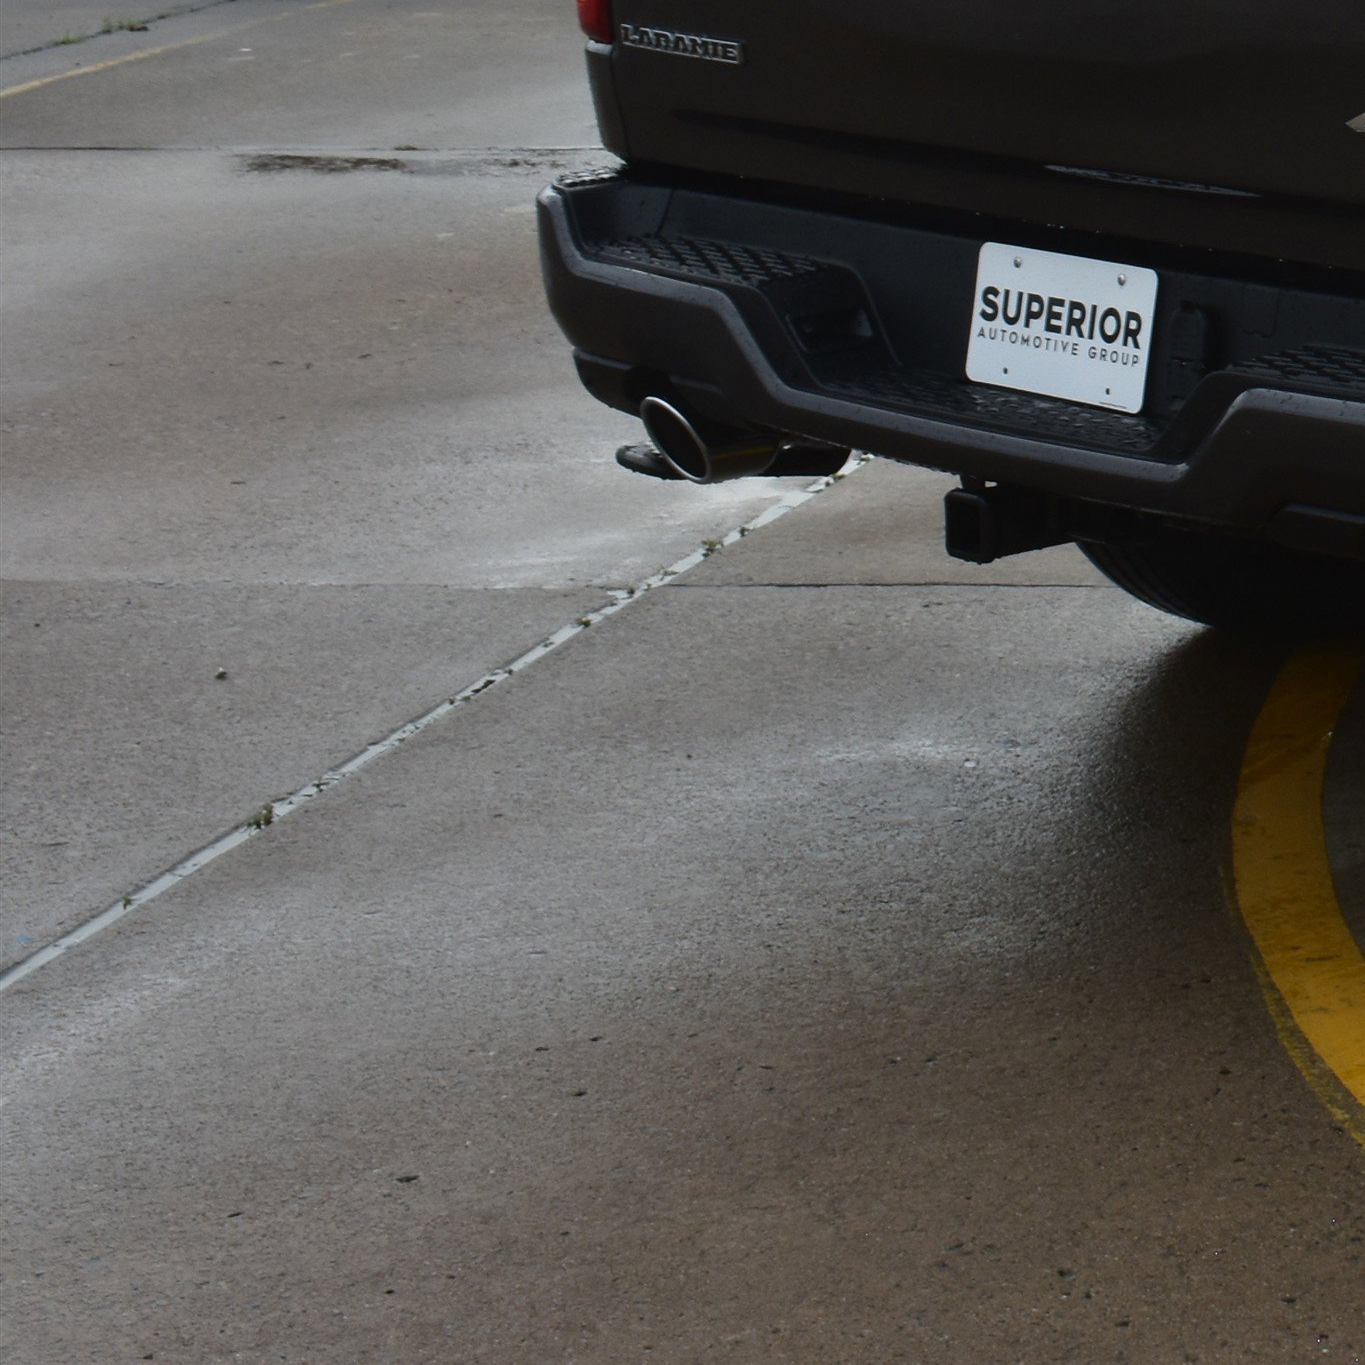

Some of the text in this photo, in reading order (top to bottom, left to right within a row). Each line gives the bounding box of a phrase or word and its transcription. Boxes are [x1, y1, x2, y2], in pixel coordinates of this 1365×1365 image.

[620, 23, 740, 64] LARAMIE
[979, 285, 1143, 350] SUPERIOR
[976, 326, 1140, 368] AUTOMOTIVE GROUP
